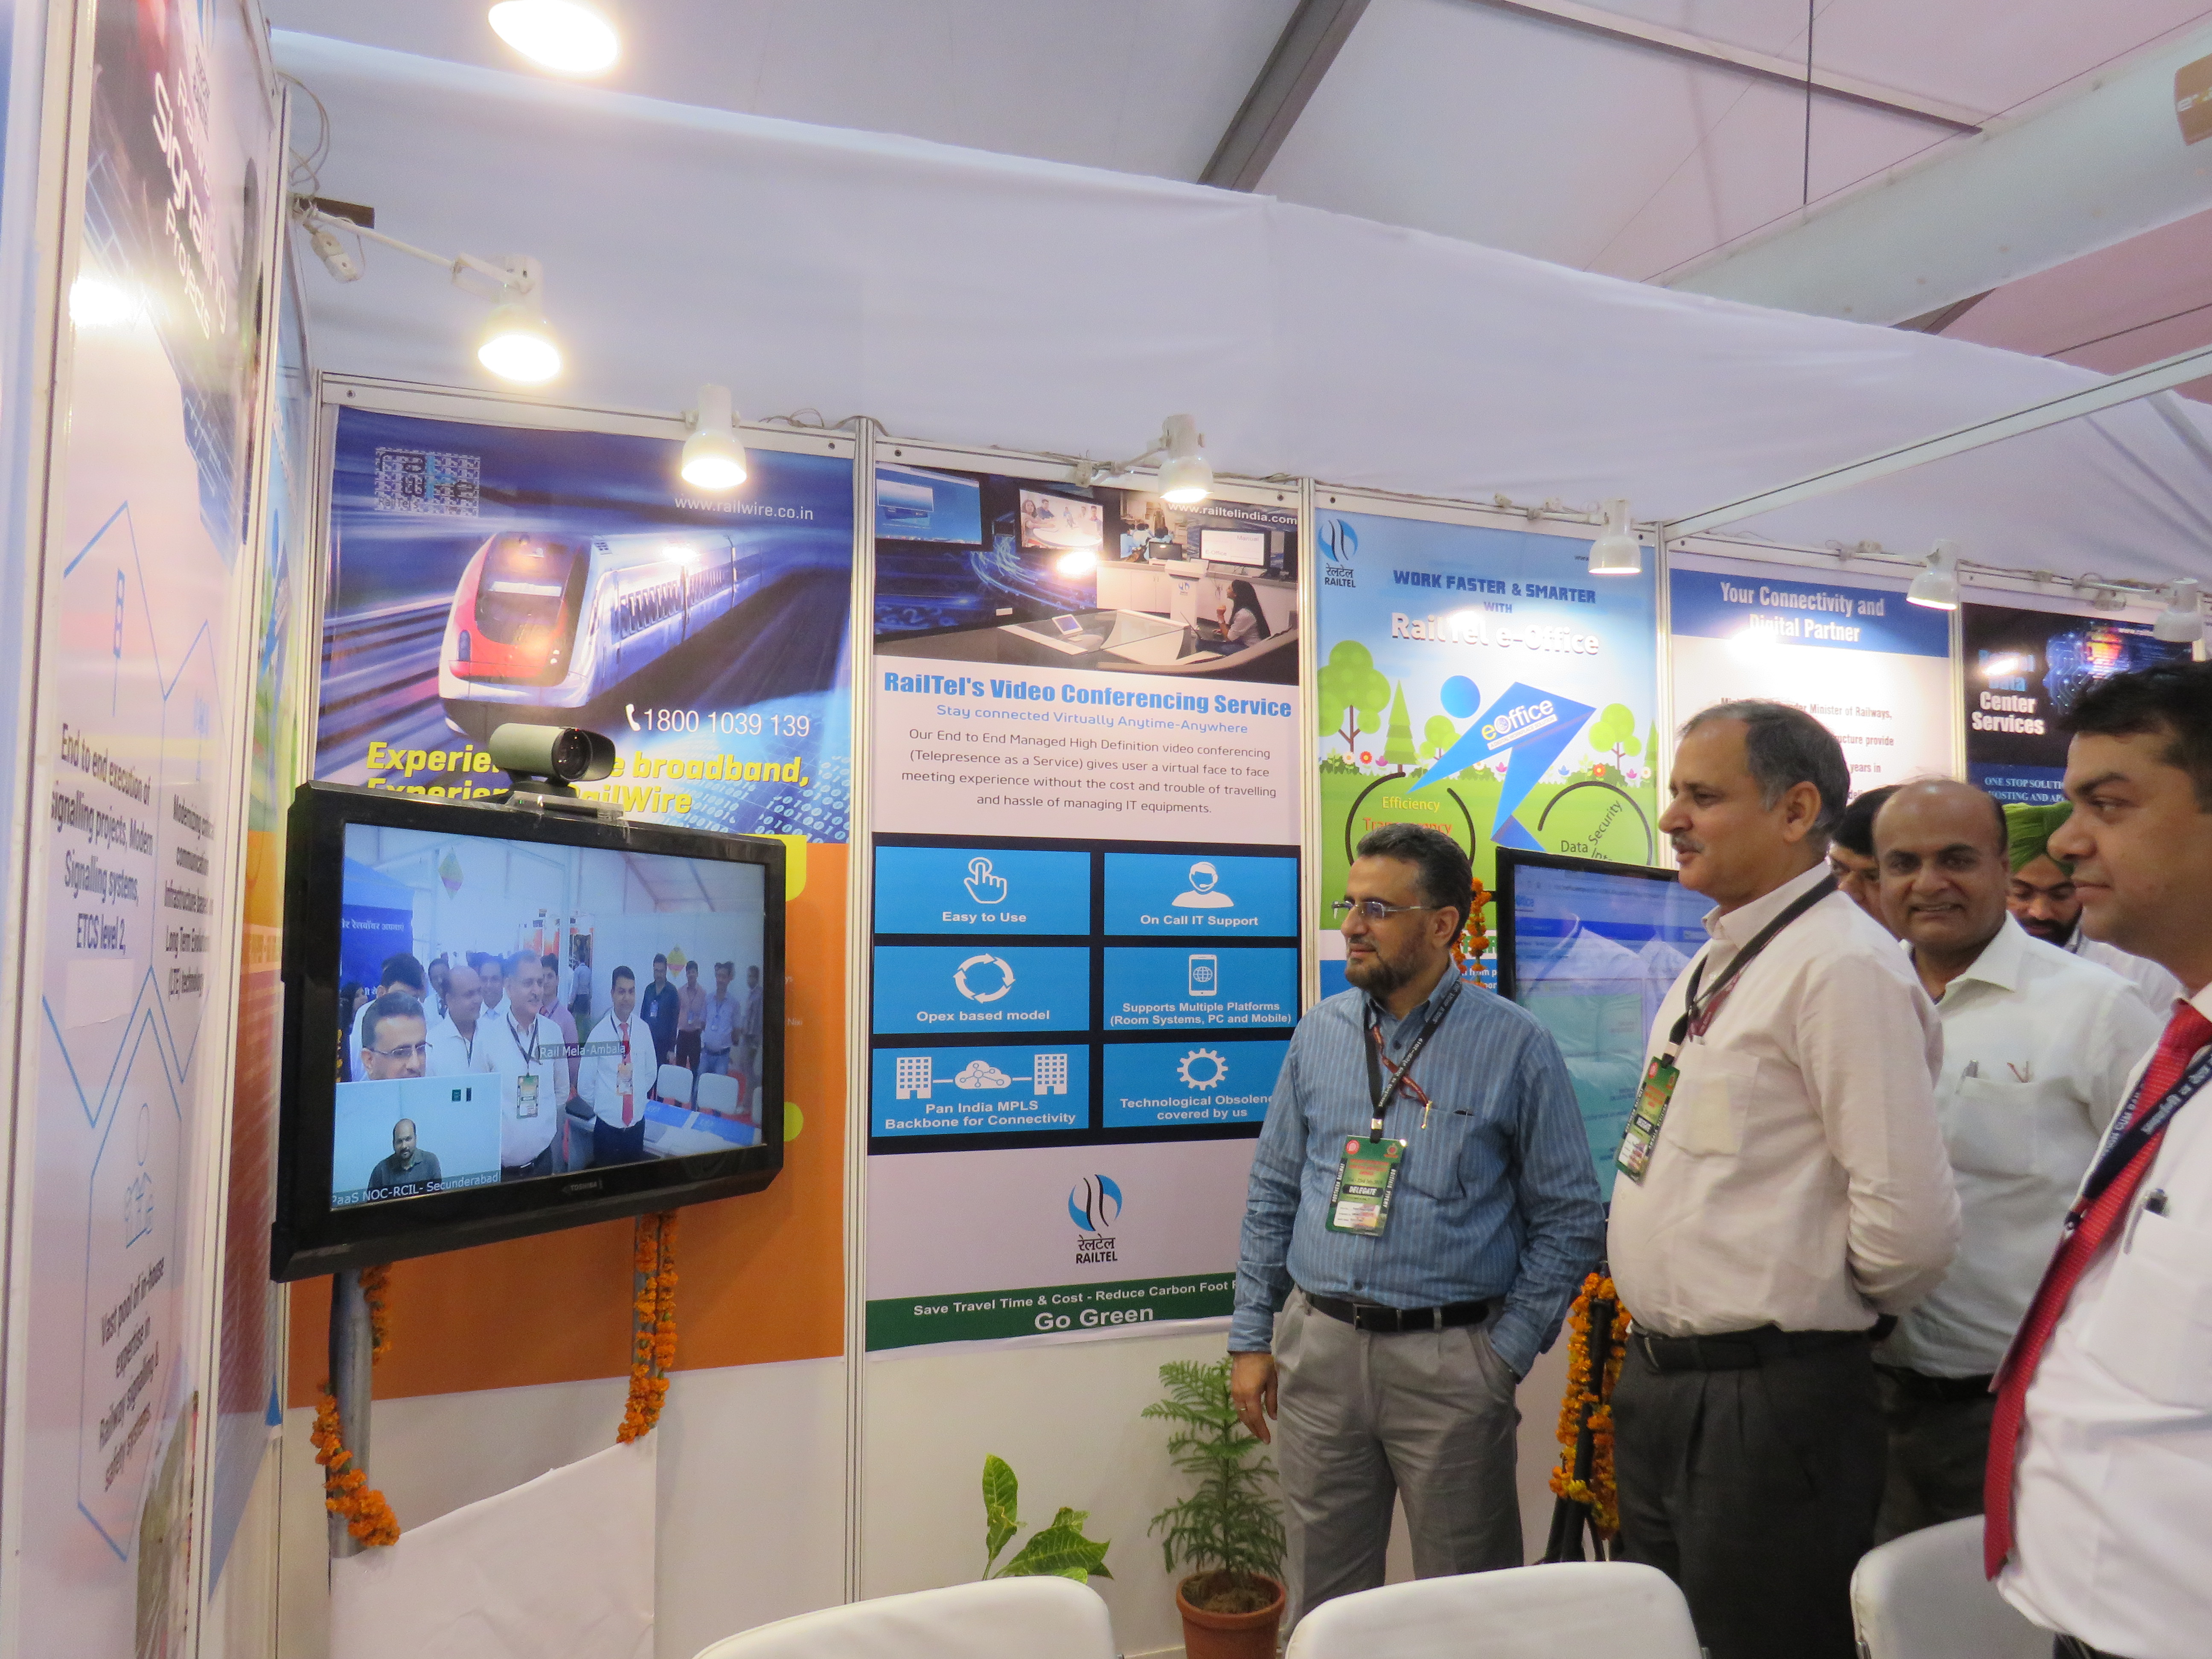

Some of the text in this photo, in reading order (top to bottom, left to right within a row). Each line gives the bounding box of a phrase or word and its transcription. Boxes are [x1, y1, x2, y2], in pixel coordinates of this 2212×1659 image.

[152, 71, 227, 335] Signalling
[166, 198, 211, 341] Projects
[674, 497, 813, 520] www.railwire.co.in
[1169, 504, 1297, 525] www.railtelindia.com
[1325, 563, 1354, 578] रेलटेल
[1324, 577, 1356, 588] RAILTEL
[1393, 570, 1597, 604] WORK FASTER & SMARTER
[1483, 601, 1512, 614] WITH
[1720, 582, 1886, 618] Your Connectivity and
[1804, 618, 1861, 642] Partner
[884, 672, 1292, 717] RailTel's Video Conferencing Service
[1980, 691, 2037, 714] Center
[937, 704, 1248, 734] Stay connected Virtually Anytime-Anywhere
[1481, 700, 1554, 740] eOffice
[1810, 704, 1893, 720] Minister of Railways,
[644, 708, 810, 737] 1800 1039 139
[1971, 711, 2045, 735] Services
[909, 729, 1271, 760] Our End to End Managed High Definition video conferencing
[1866, 736, 1895, 747] provide
[61, 722, 80, 767] End
[81, 738, 91, 773] to
[93, 748, 108, 783] end
[143, 776, 151, 806] of
[633, 751, 810, 788] broadband,
[910, 750, 1001, 764] (Telepresence
[1005, 757, 1019, 765] as
[1033, 756, 1083, 770] Service)
[1086, 759, 1118, 771] gives
[1122, 762, 1148, 771] user
[1151, 764, 1158, 772] a
[1162, 763, 1199, 774] virtual
[1202, 764, 1228, 775] face
[1231, 766, 1243, 776] to
[1246, 767, 1270, 777] face
[1849, 763, 1881, 774] years in
[902, 771, 1277, 799] meeting experience without the cost and trouble of travelling
[1984, 776, 2028, 787] ONE STOP
[977, 795, 1212, 814] and hassle of managing IT equipments.
[1382, 796, 1440, 813] Efficiency
[2031, 793, 2049, 802] AND
[1561, 800, 1622, 853] Data Security
[65, 849, 107, 903] Signalling
[942, 911, 1027, 924] Easy to Use
[1140, 915, 1259, 928] On Call IT Support
[76, 913, 99, 949] ETCS
[100, 914, 119, 950] level
[916, 1010, 1050, 1024] Opex based model
[1122, 1002, 1280, 1014] Supports Multiple Platforms
[1110, 1013, 1292, 1027] (Room Systems, PC and Mobile)
[540, 1042, 626, 1058] Rail Mela-Ambala
[925, 1100, 1039, 1114] Pan India MPLS
[1120, 1095, 1211, 1109] Technological
[885, 1113, 1076, 1129] Backbone for Connectivity
[1157, 1108, 1248, 1120] covered by us
[426, 1172, 499, 1192] Secunderabad
[1349, 1186, 1377, 1195] DELEGATE
[1077, 1233, 1116, 1251] रेलटेल
[1076, 1251, 1118, 1264] RAILTEL
[914, 1305, 949, 1316] Save
[953, 1299, 995, 1313] Travel
[1000, 1297, 1033, 1309] Time
[1037, 1295, 1047, 1306] &
[1051, 1293, 1083, 1304] Cost
[1095, 1289, 1144, 1301] Reduce
[1149, 1284, 1196, 1297] Carbon
[1199, 1281, 1228, 1293] Foot
[1034, 1307, 1153, 1330] Go Green
